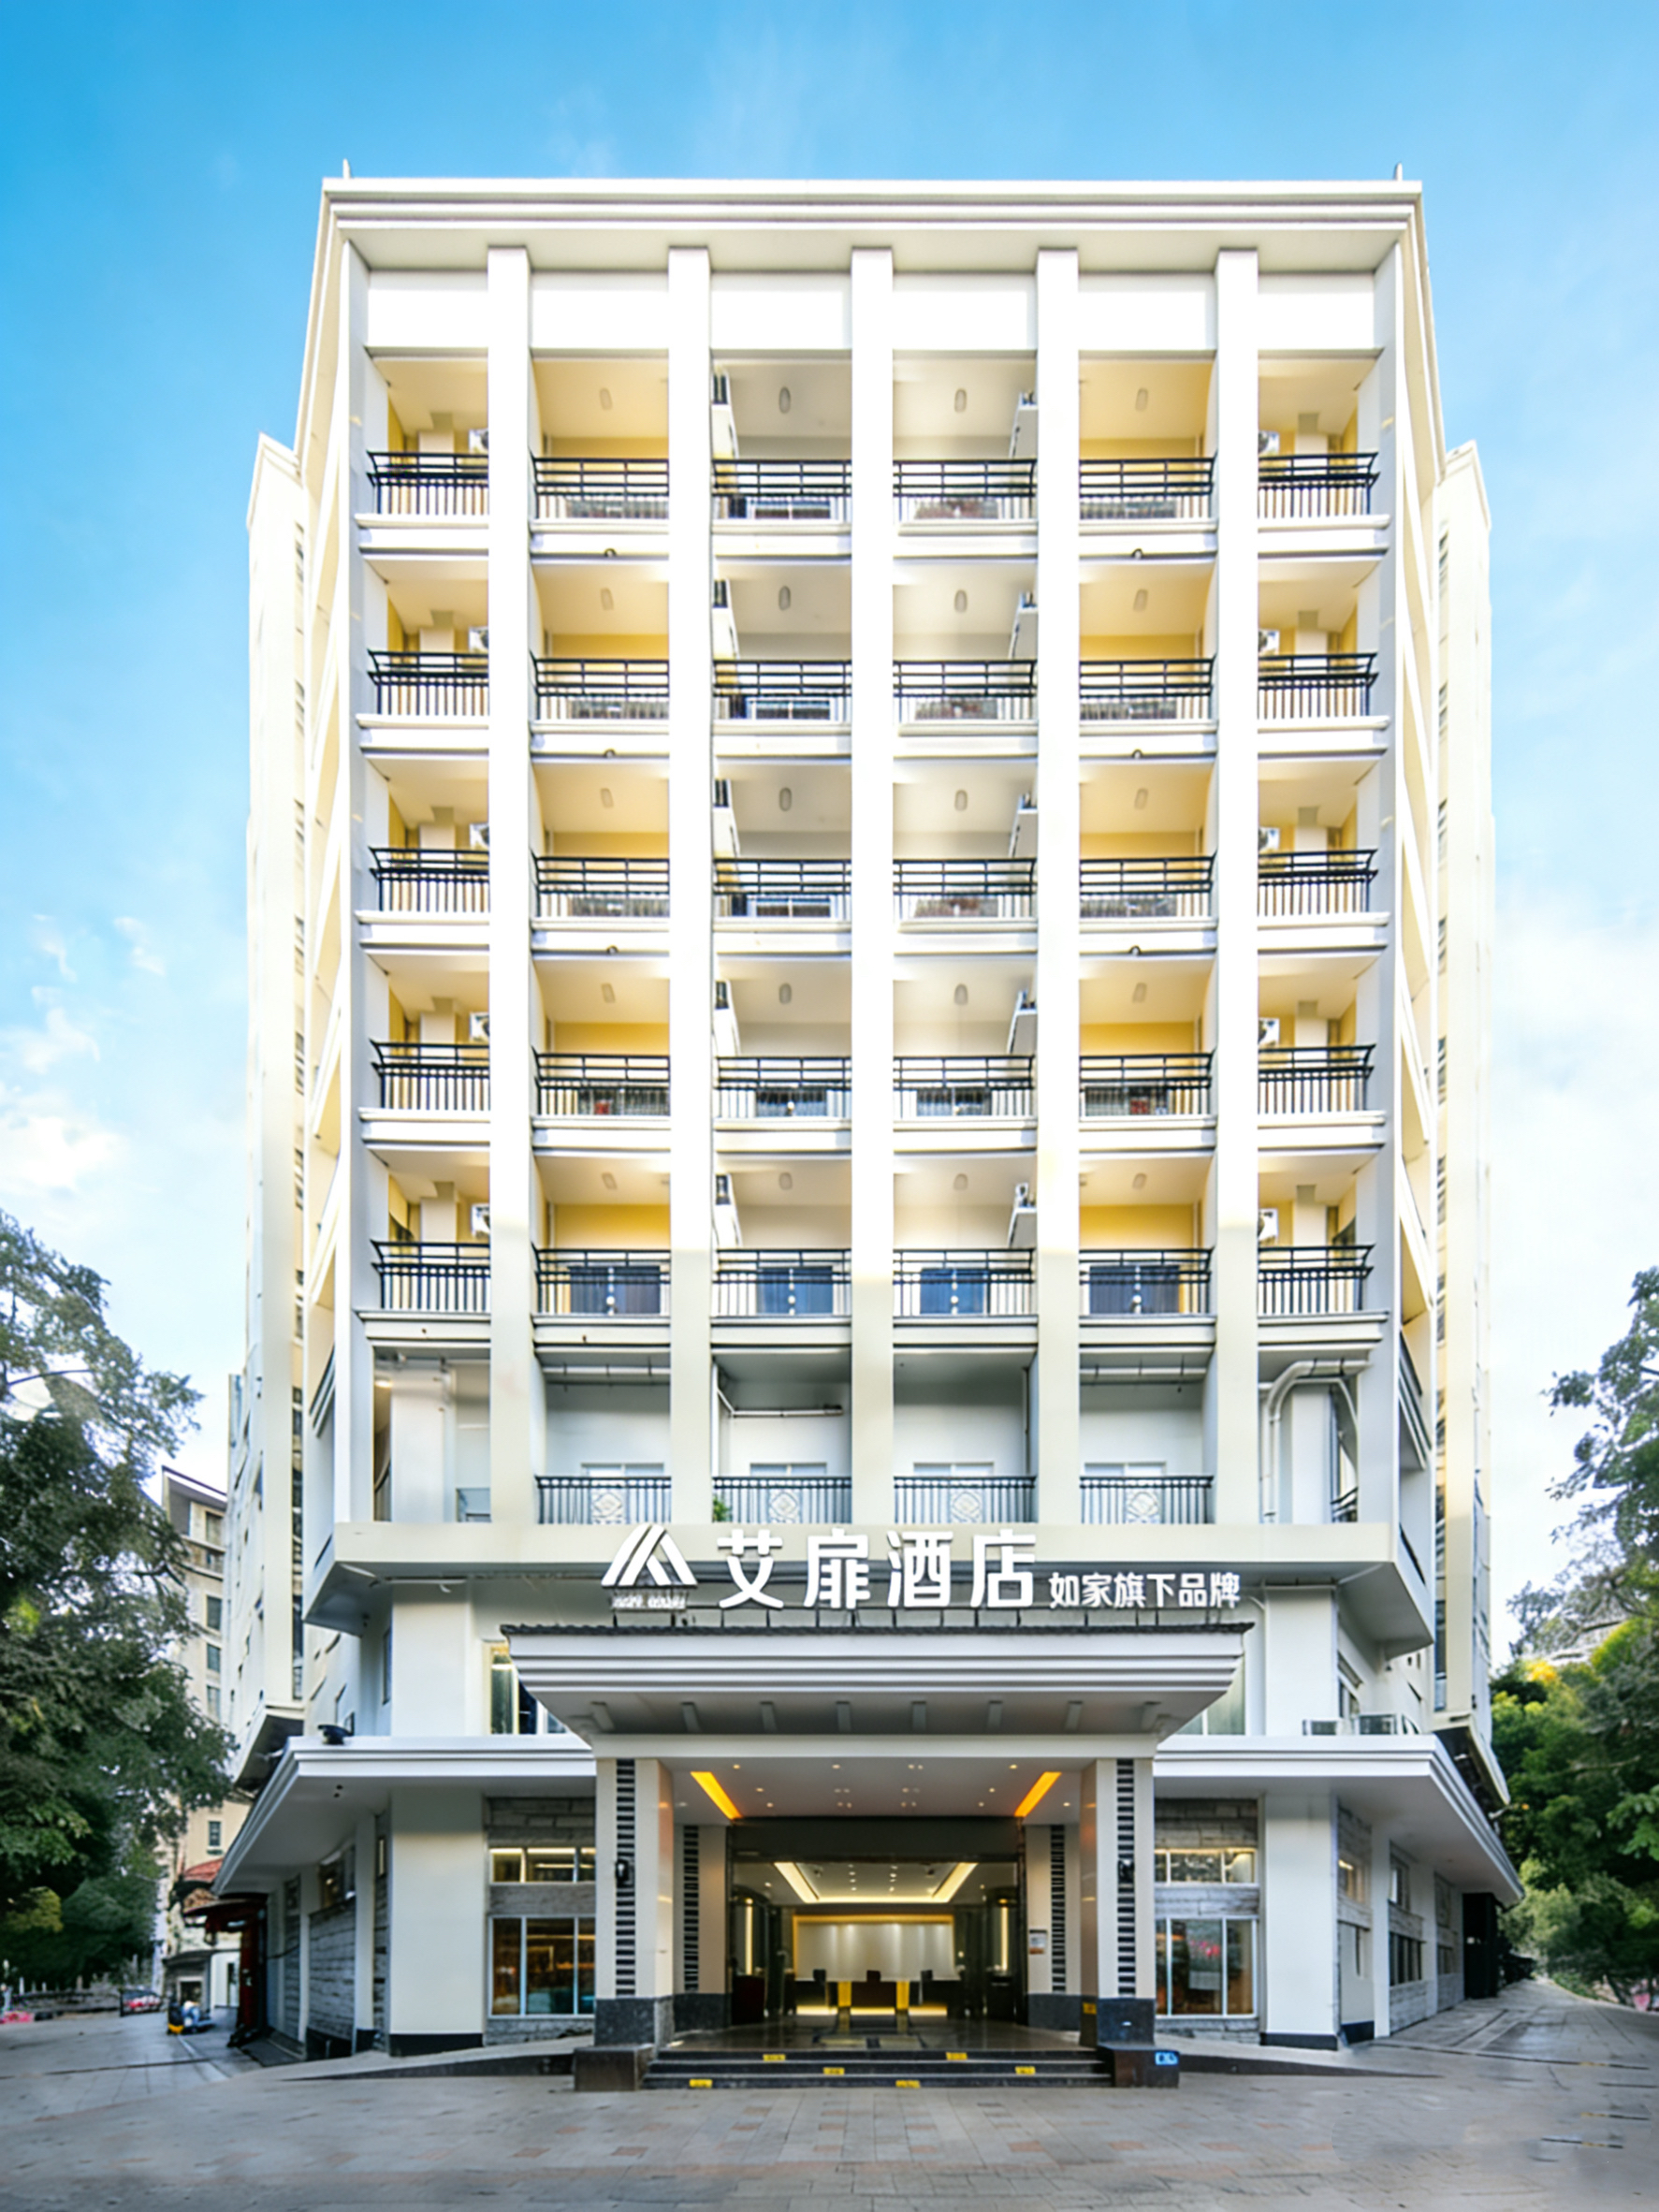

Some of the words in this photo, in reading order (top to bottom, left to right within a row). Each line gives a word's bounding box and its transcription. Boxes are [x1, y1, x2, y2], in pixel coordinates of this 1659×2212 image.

[718, 1527, 1036, 1609] 艾扉酒店
[1048, 1572, 1240, 1608] 如家旗下品牌
